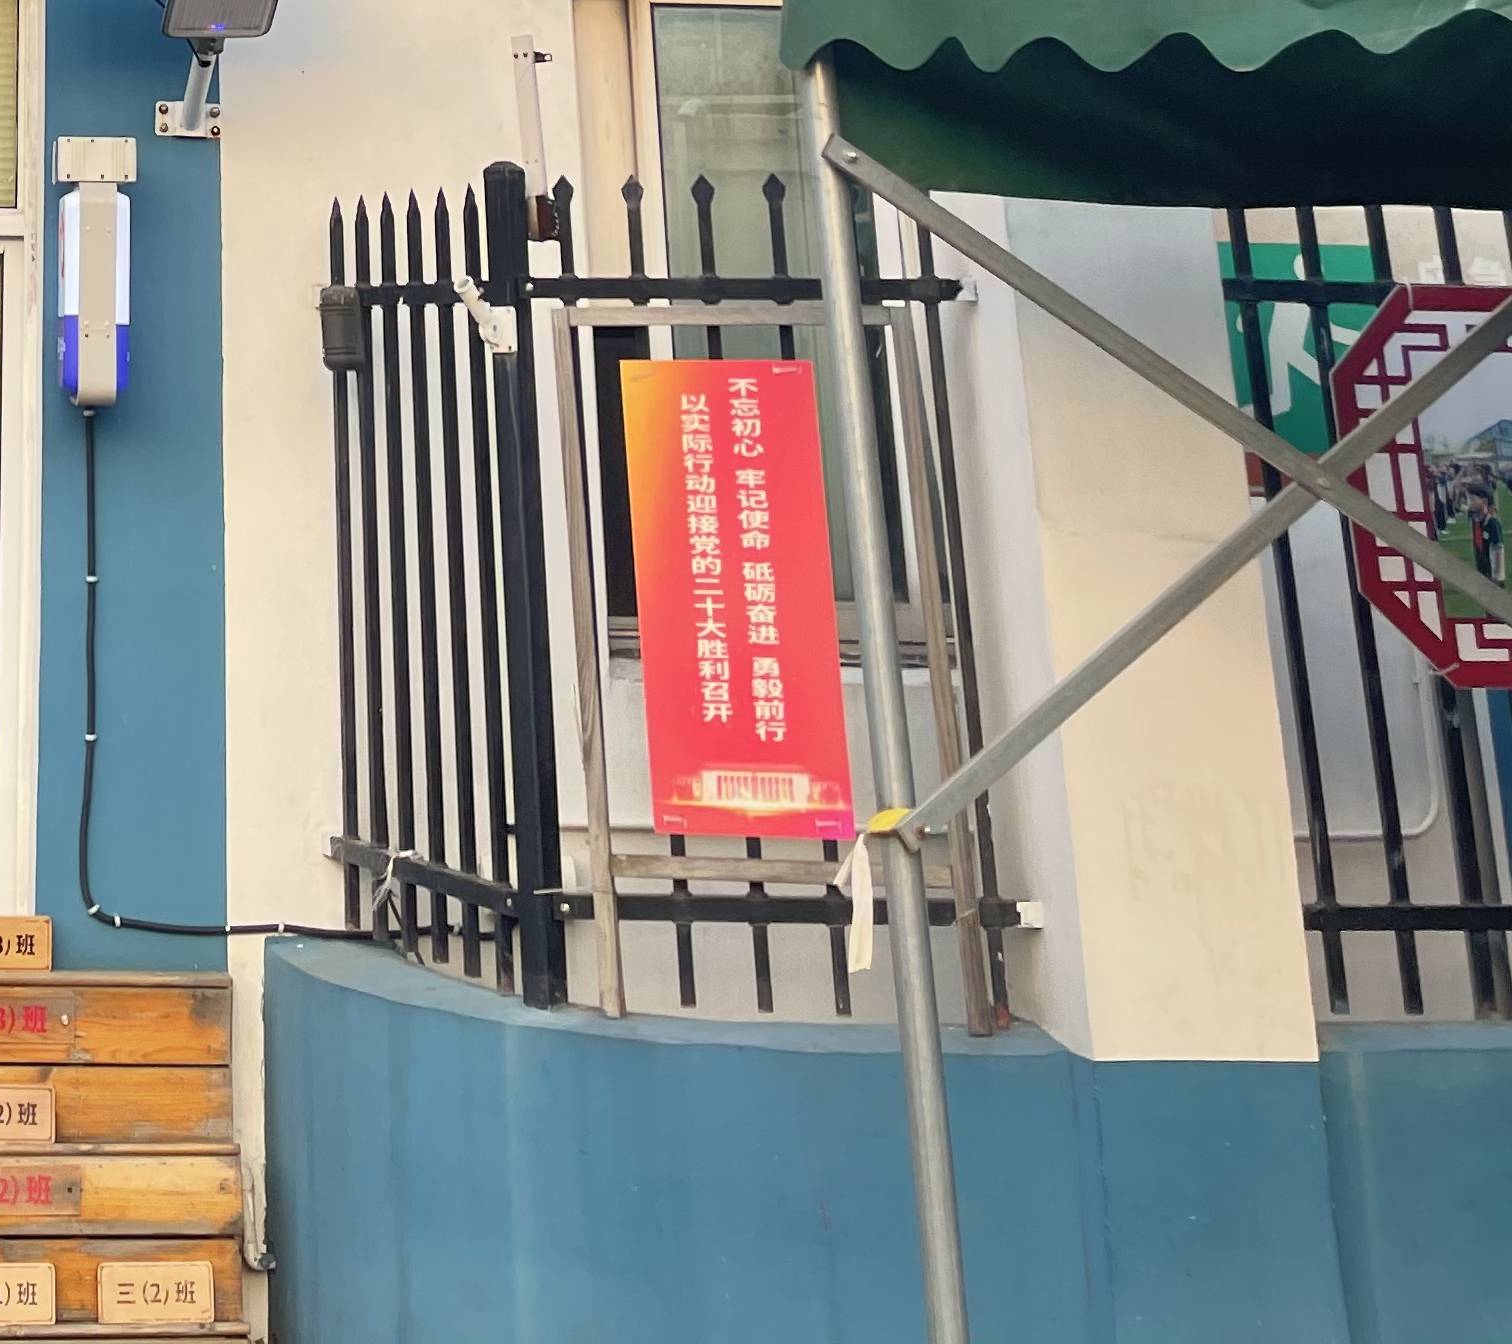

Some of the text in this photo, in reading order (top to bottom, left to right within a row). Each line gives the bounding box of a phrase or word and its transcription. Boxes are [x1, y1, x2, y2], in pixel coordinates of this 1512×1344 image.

[680, 393, 733, 724] 以实际行动迎接党的二十大胜利召开
[727, 377, 787, 743] 不忘初心 牢记使命 砥砺奋进 勇毅前行
